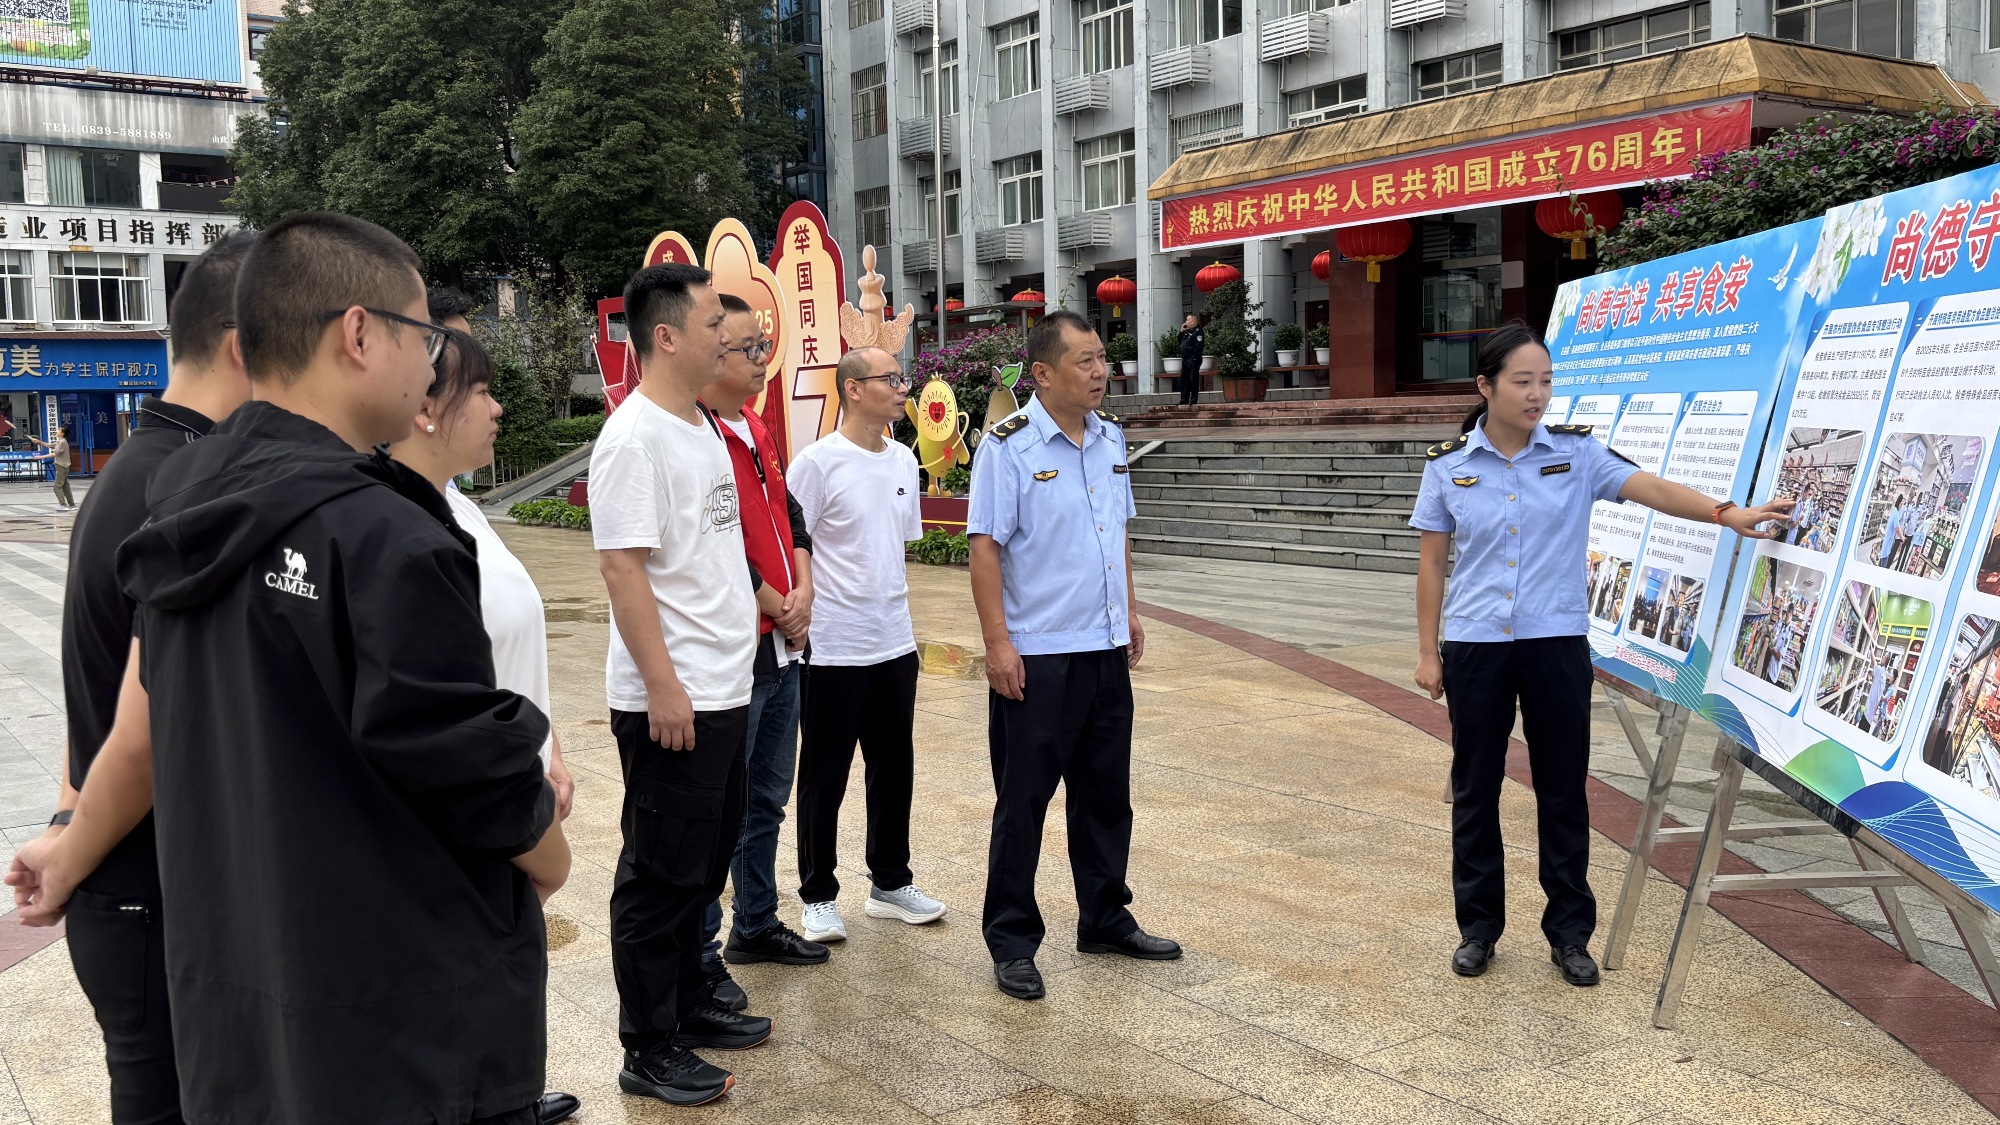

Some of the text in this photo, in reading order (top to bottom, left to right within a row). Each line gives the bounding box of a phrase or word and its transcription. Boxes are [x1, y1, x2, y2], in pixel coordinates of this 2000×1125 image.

[81, 125, 172, 140] 0839-5881889
[0, 216, 227, 246] 业项目指挥部
[793, 223, 819, 365] 举国同庆
[1574, 254, 1754, 335] 尚德守法 共享食安
[45, 361, 158, 377] 为学生保护视力
[265, 572, 320, 600] CAMEL
